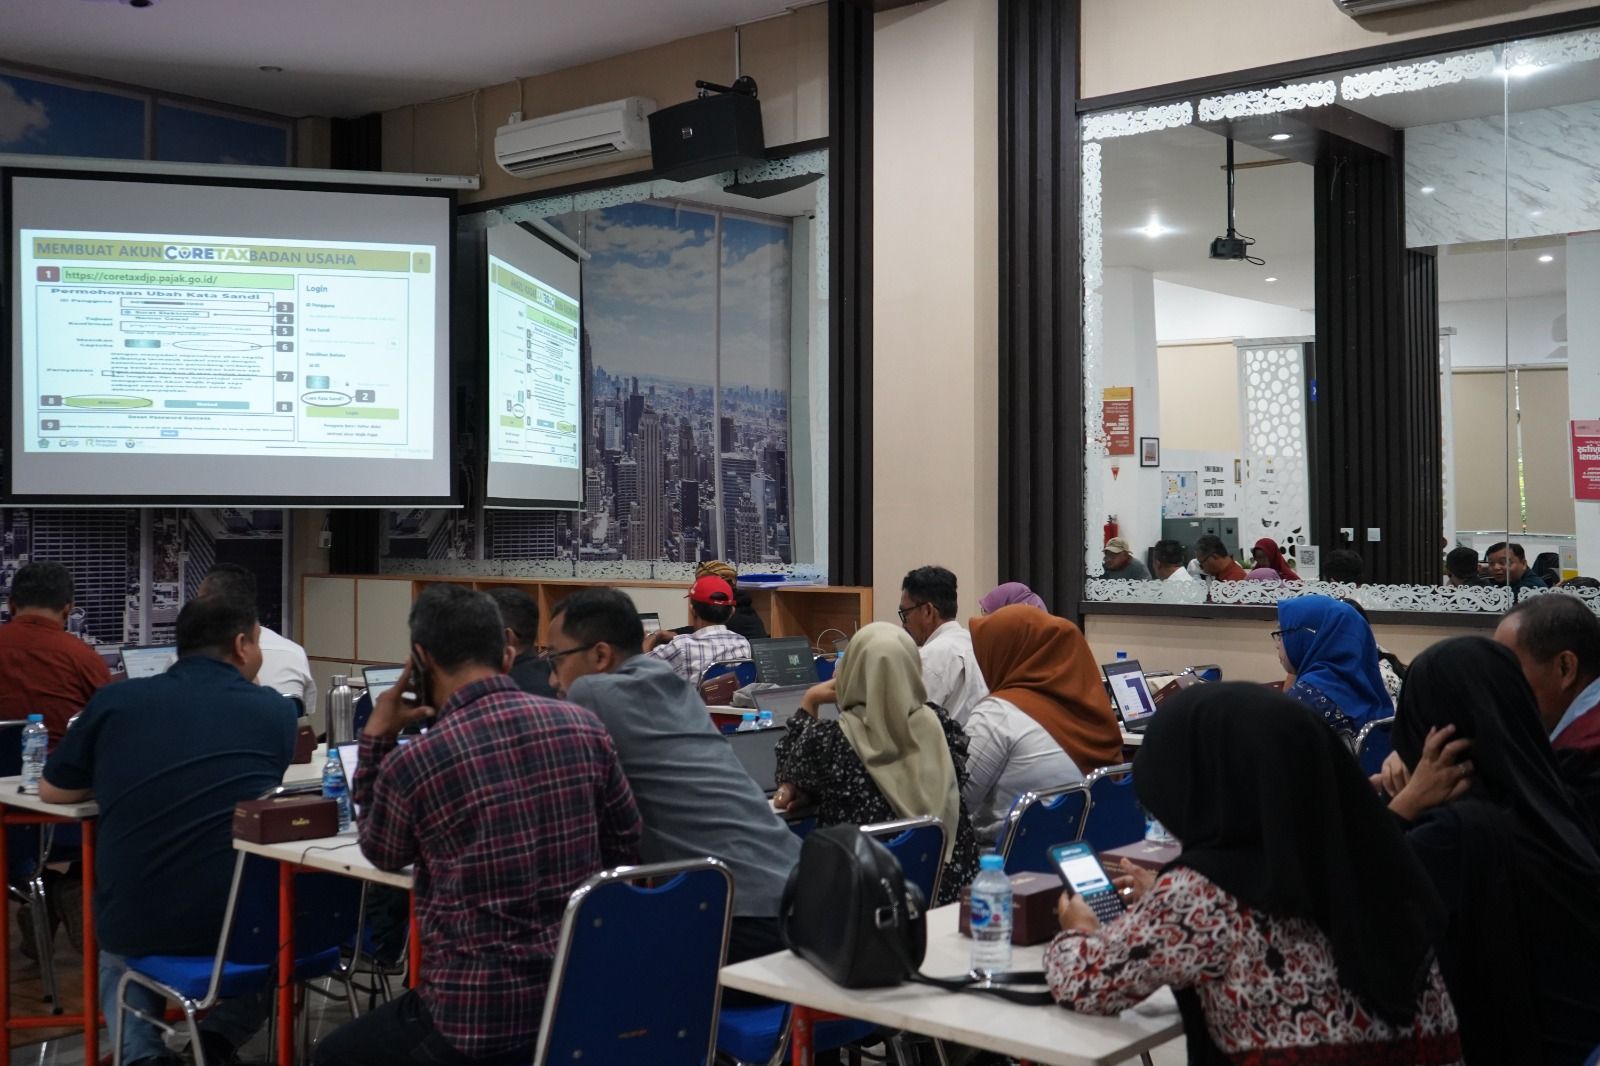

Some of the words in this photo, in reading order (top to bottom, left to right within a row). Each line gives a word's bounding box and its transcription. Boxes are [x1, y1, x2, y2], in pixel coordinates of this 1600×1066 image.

[37, 243, 114, 256] MEMBUAT
[119, 244, 162, 258] AKUN
[250, 250, 301, 263] BADAN
[306, 252, 356, 266] USAHA
[65, 270, 218, 284] https://coretaxdjp.pajak.go.id/
[51, 288, 142, 296] Permohonan
[306, 284, 328, 293] Login
